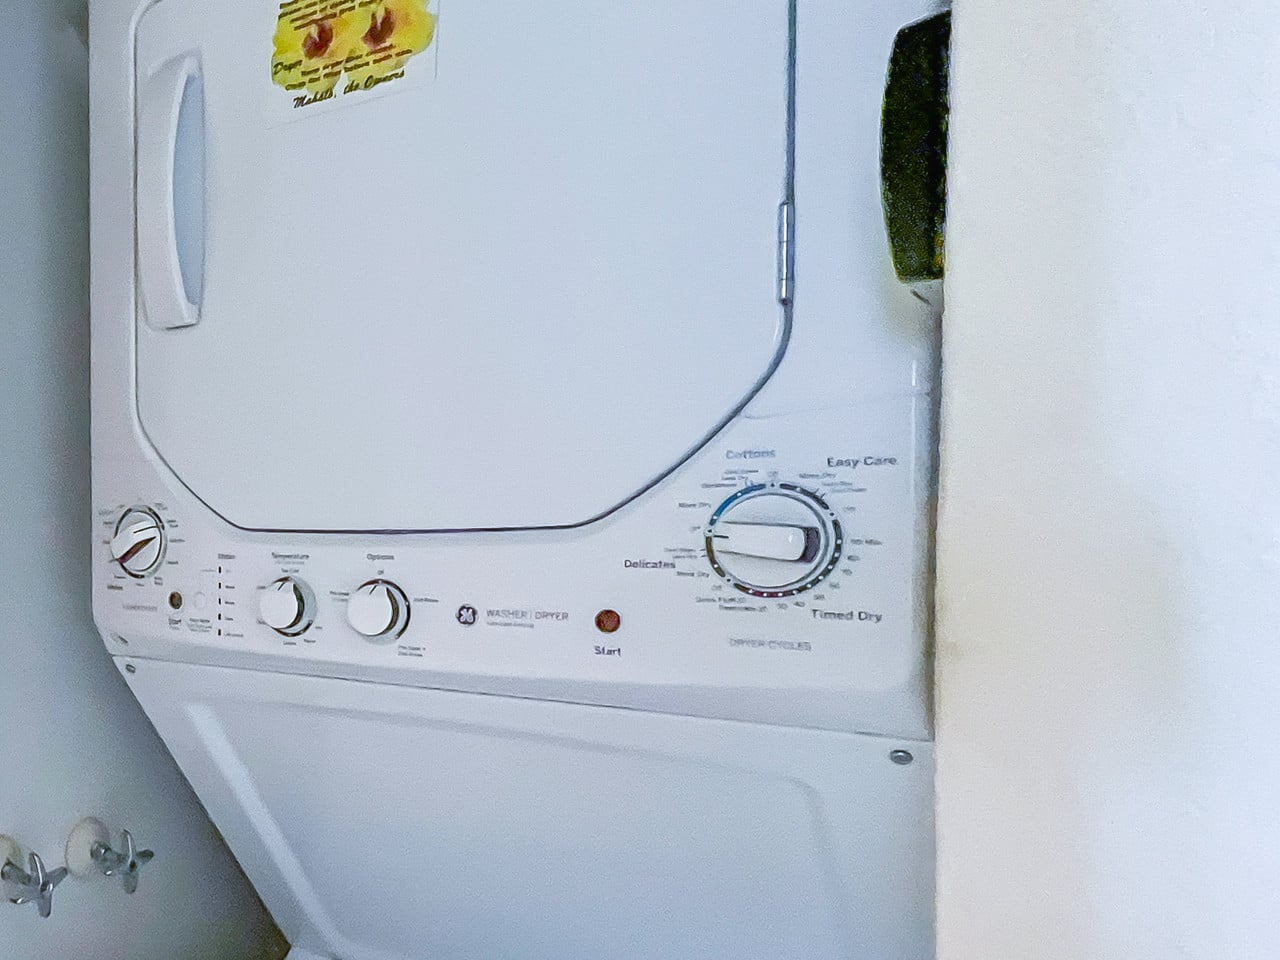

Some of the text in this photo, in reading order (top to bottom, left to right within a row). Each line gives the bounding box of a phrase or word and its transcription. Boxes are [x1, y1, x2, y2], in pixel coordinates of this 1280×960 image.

[826, 456, 897, 469] Easy Care
[624, 560, 676, 569] Delicates
[486, 609, 569, 621] WASHER DRYER
[812, 608, 882, 623] Timed Dry
[594, 646, 621, 657] Start
